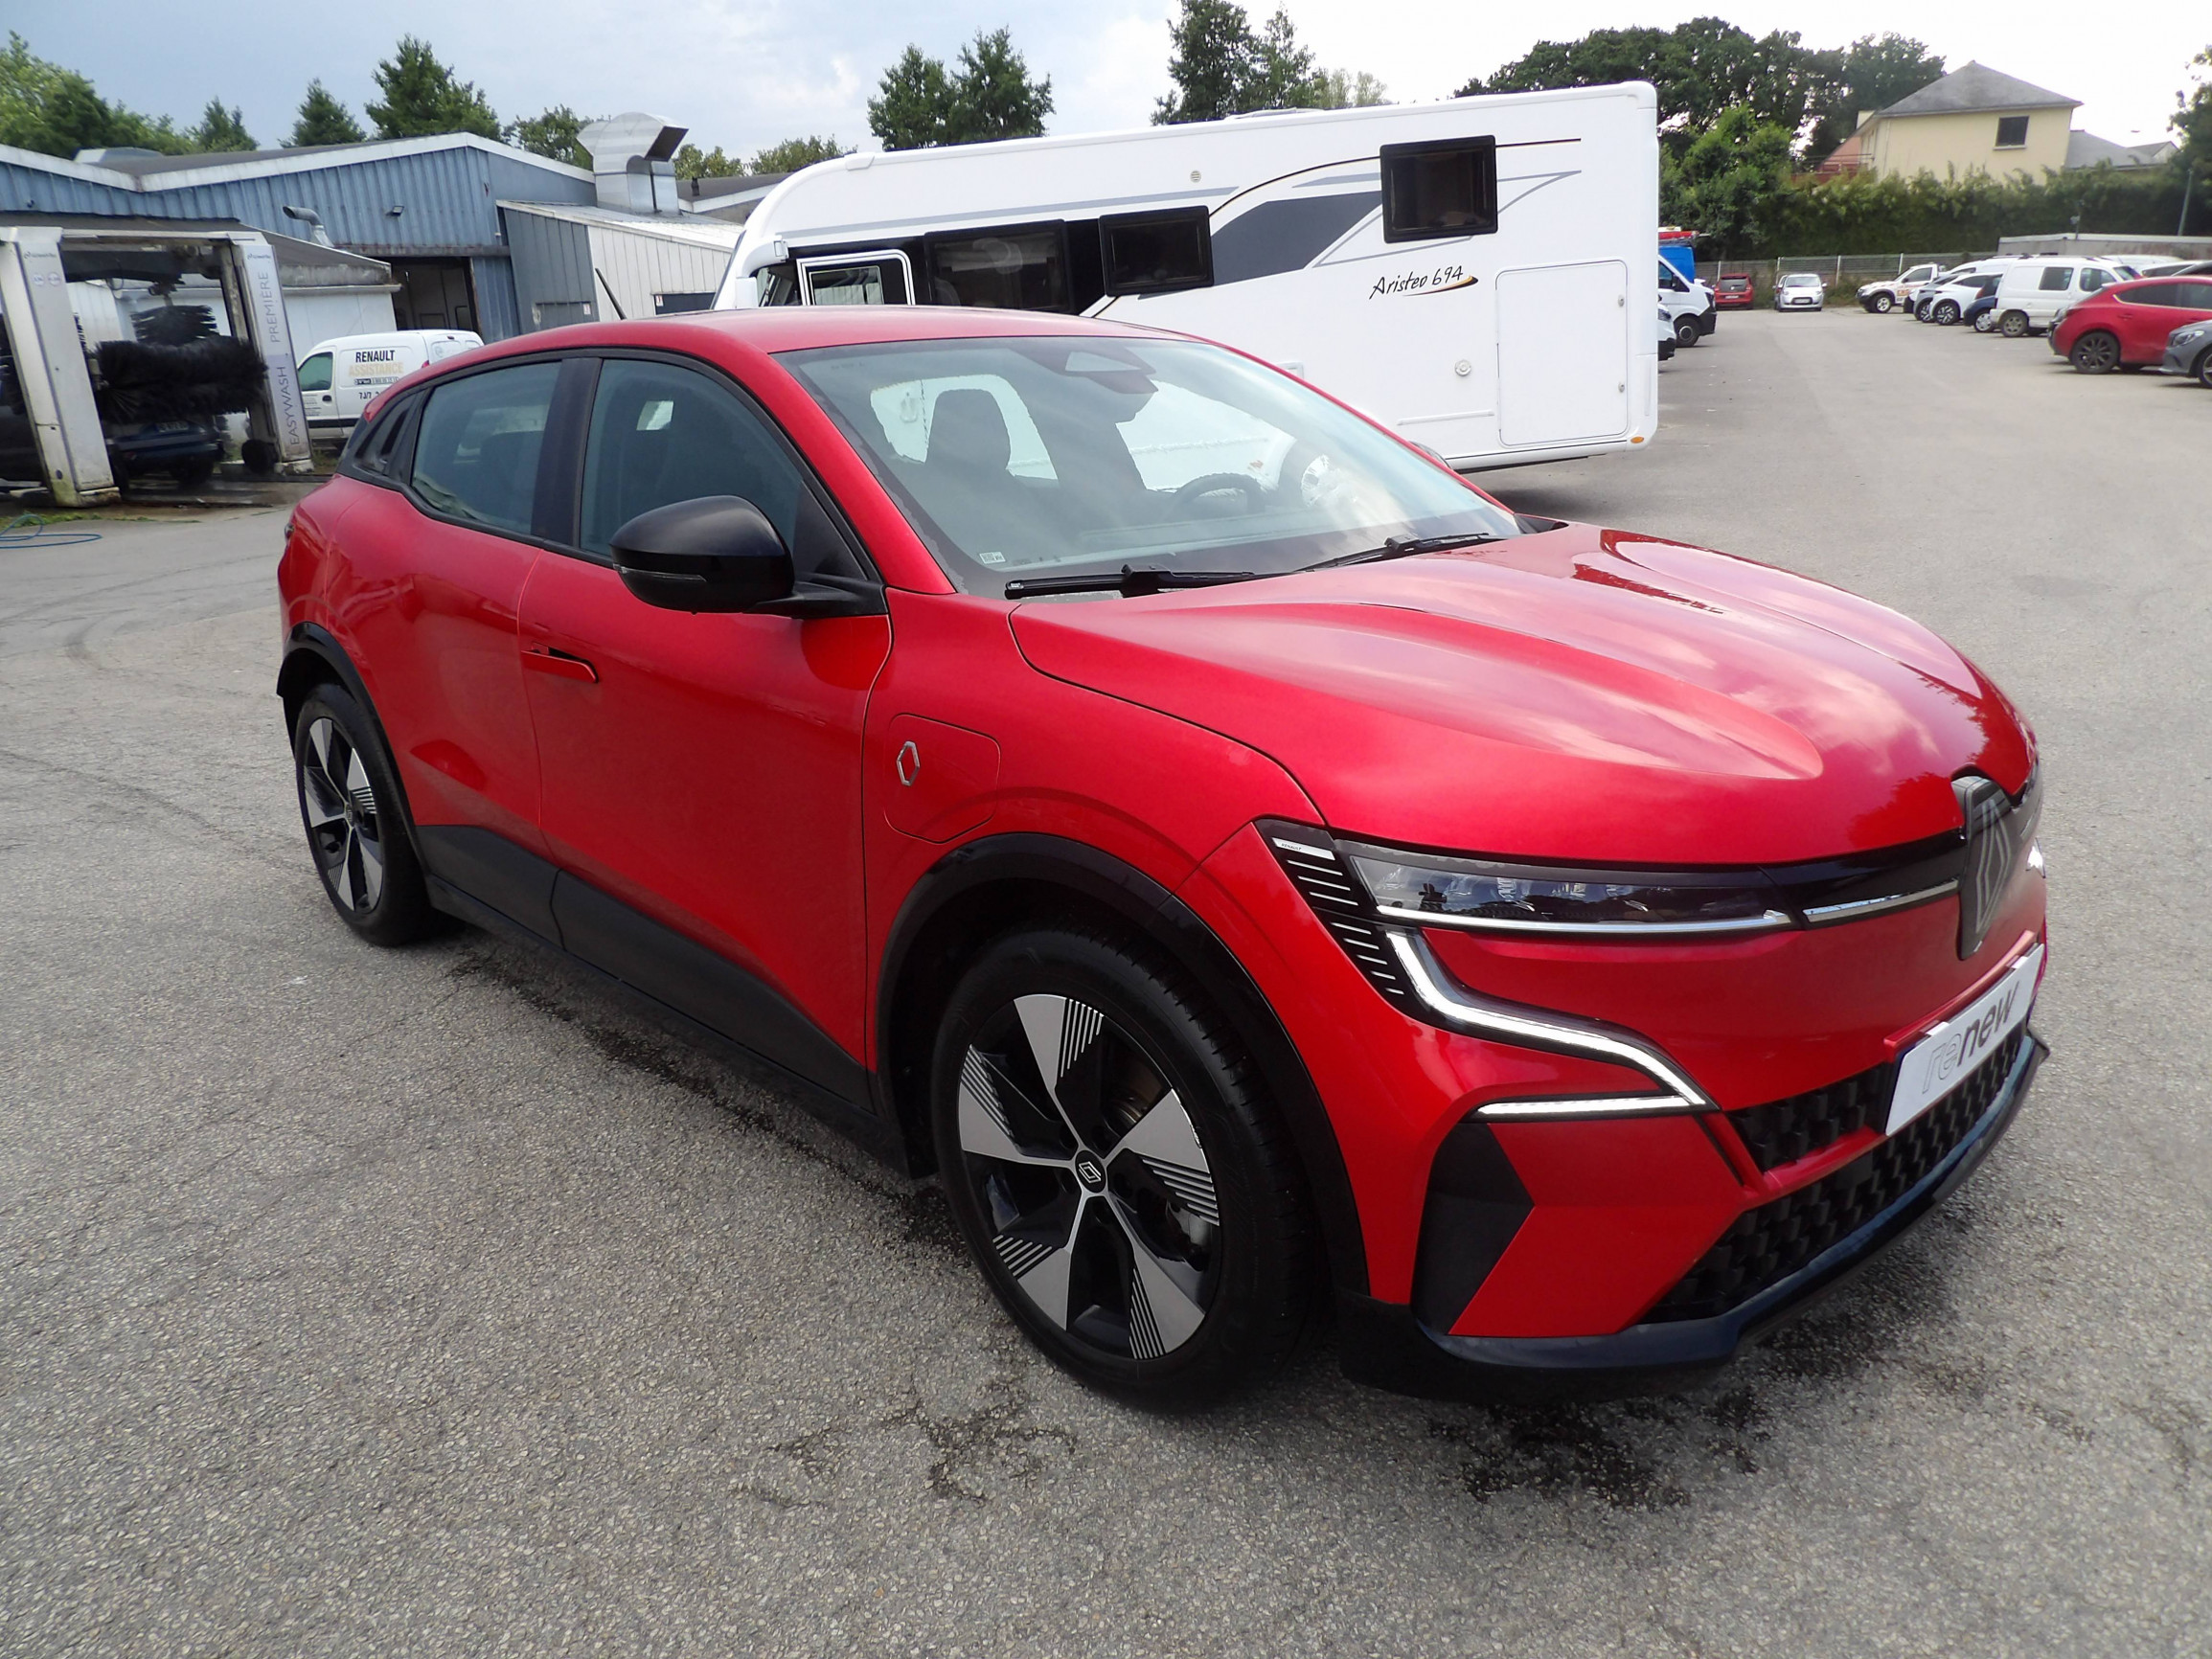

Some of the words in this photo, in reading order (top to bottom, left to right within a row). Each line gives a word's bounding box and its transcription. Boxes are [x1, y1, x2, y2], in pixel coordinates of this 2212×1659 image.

[1368, 271, 1428, 300] Aristeo
[1431, 265, 1464, 285] 694
[349, 362, 404, 376] ASSISTANCE
[355, 350, 395, 363] RENAULT
[276, 366, 299, 445] EASYWASH
[1922, 980, 2020, 1094] renew
